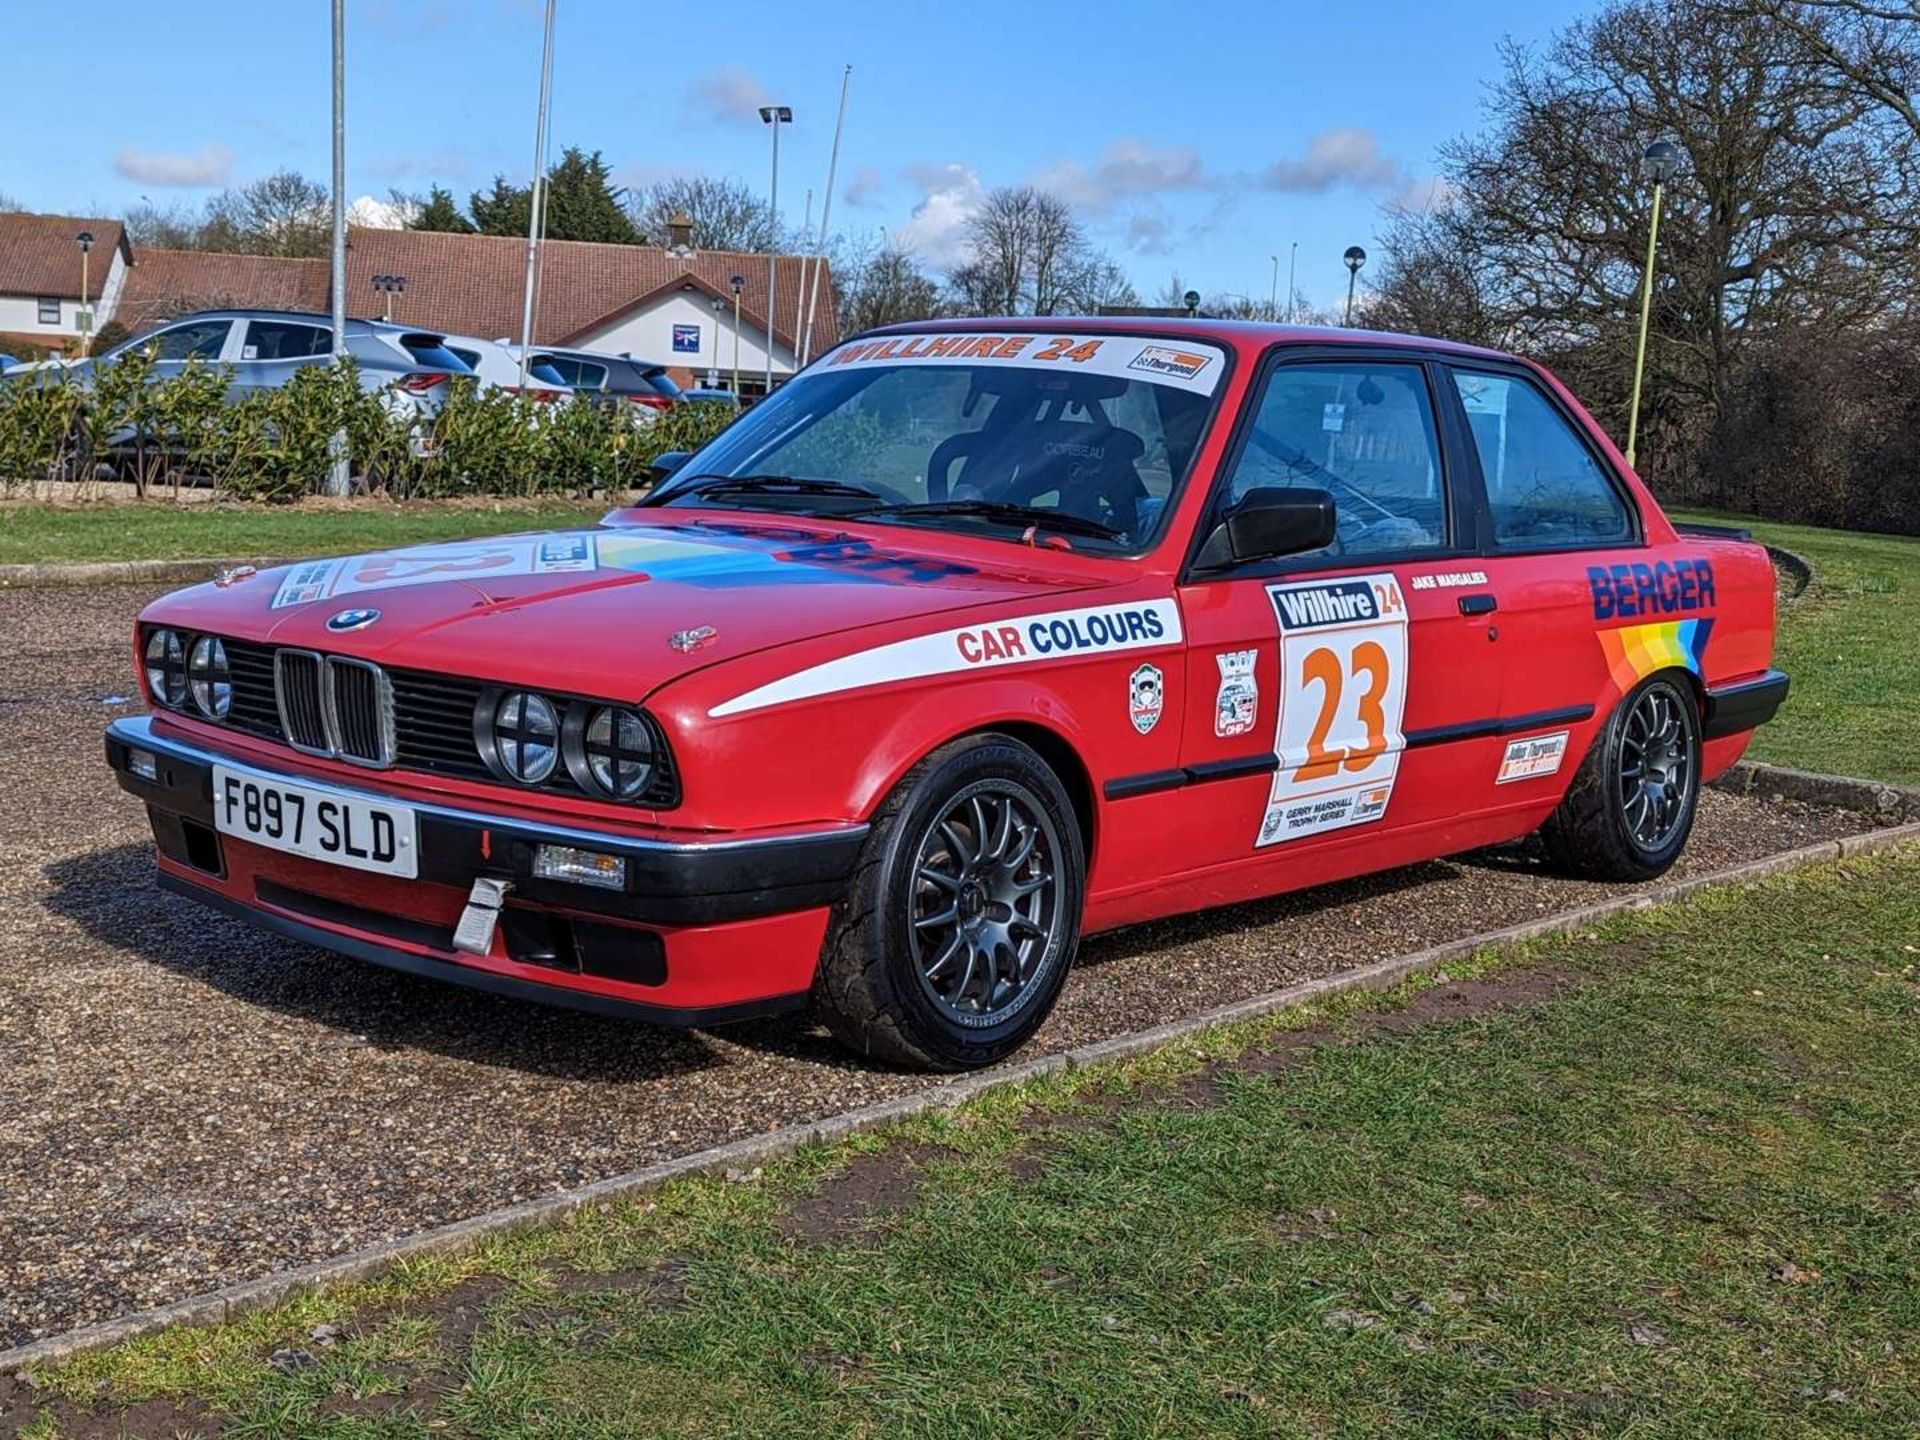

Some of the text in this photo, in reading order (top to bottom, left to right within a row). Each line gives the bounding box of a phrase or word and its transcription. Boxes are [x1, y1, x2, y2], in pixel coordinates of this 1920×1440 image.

[828, 336, 1105, 366] WILLHIRE 24
[1278, 583, 1402, 626] Willhire 24
[1411, 575, 1437, 590] JAKE
[1586, 559, 1716, 620] BERGER
[956, 608, 1165, 664] CAR COLOURS
[1292, 640, 1390, 783] 23
[224, 776, 396, 863] F897 SLD
